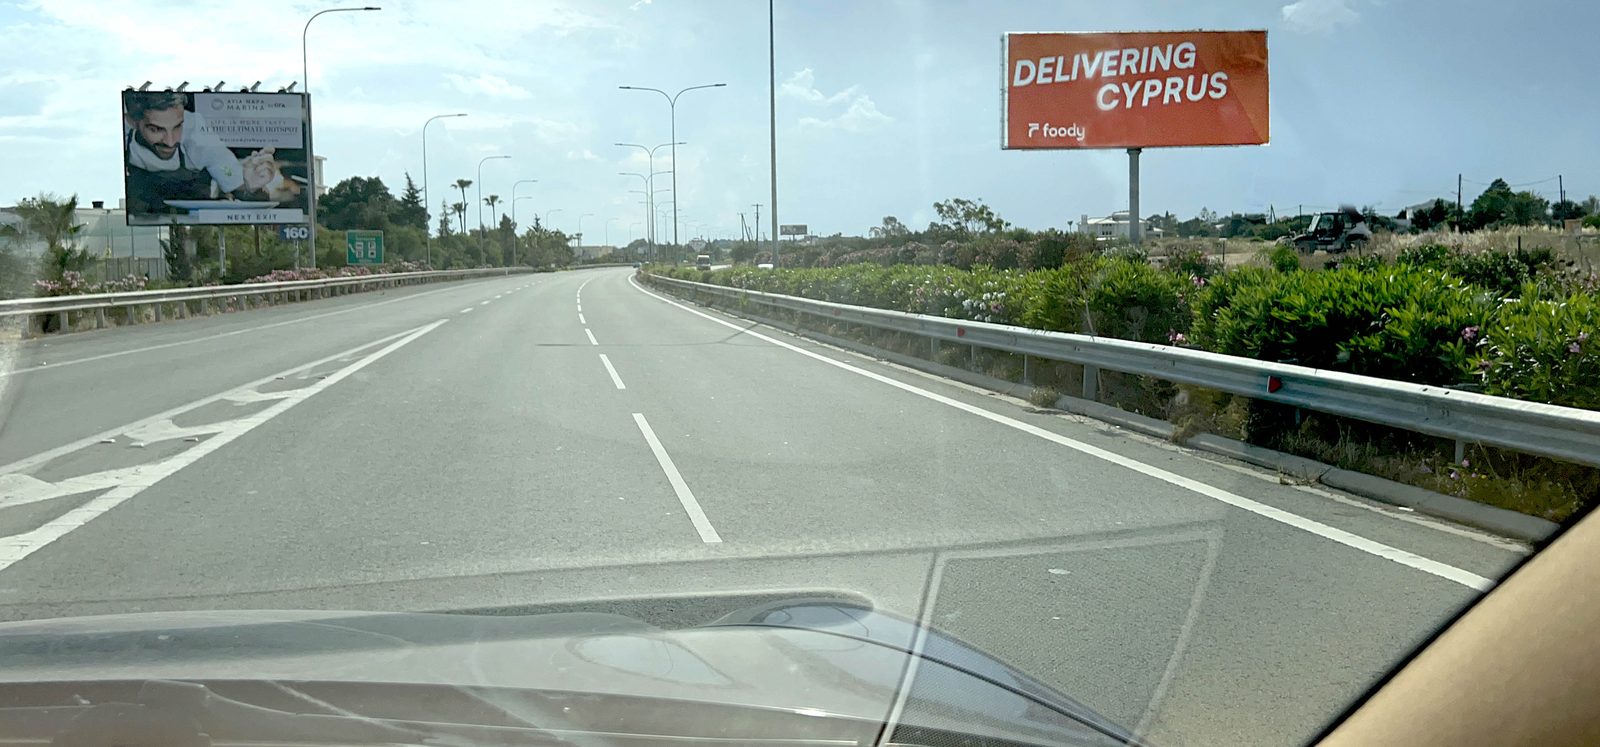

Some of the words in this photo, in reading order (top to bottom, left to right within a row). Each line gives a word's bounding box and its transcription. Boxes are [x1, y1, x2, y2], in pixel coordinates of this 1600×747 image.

[1013, 42, 1196, 87] DELIVERING
[1096, 71, 1228, 111] CYPRUS
[1043, 122, 1085, 141] foody
